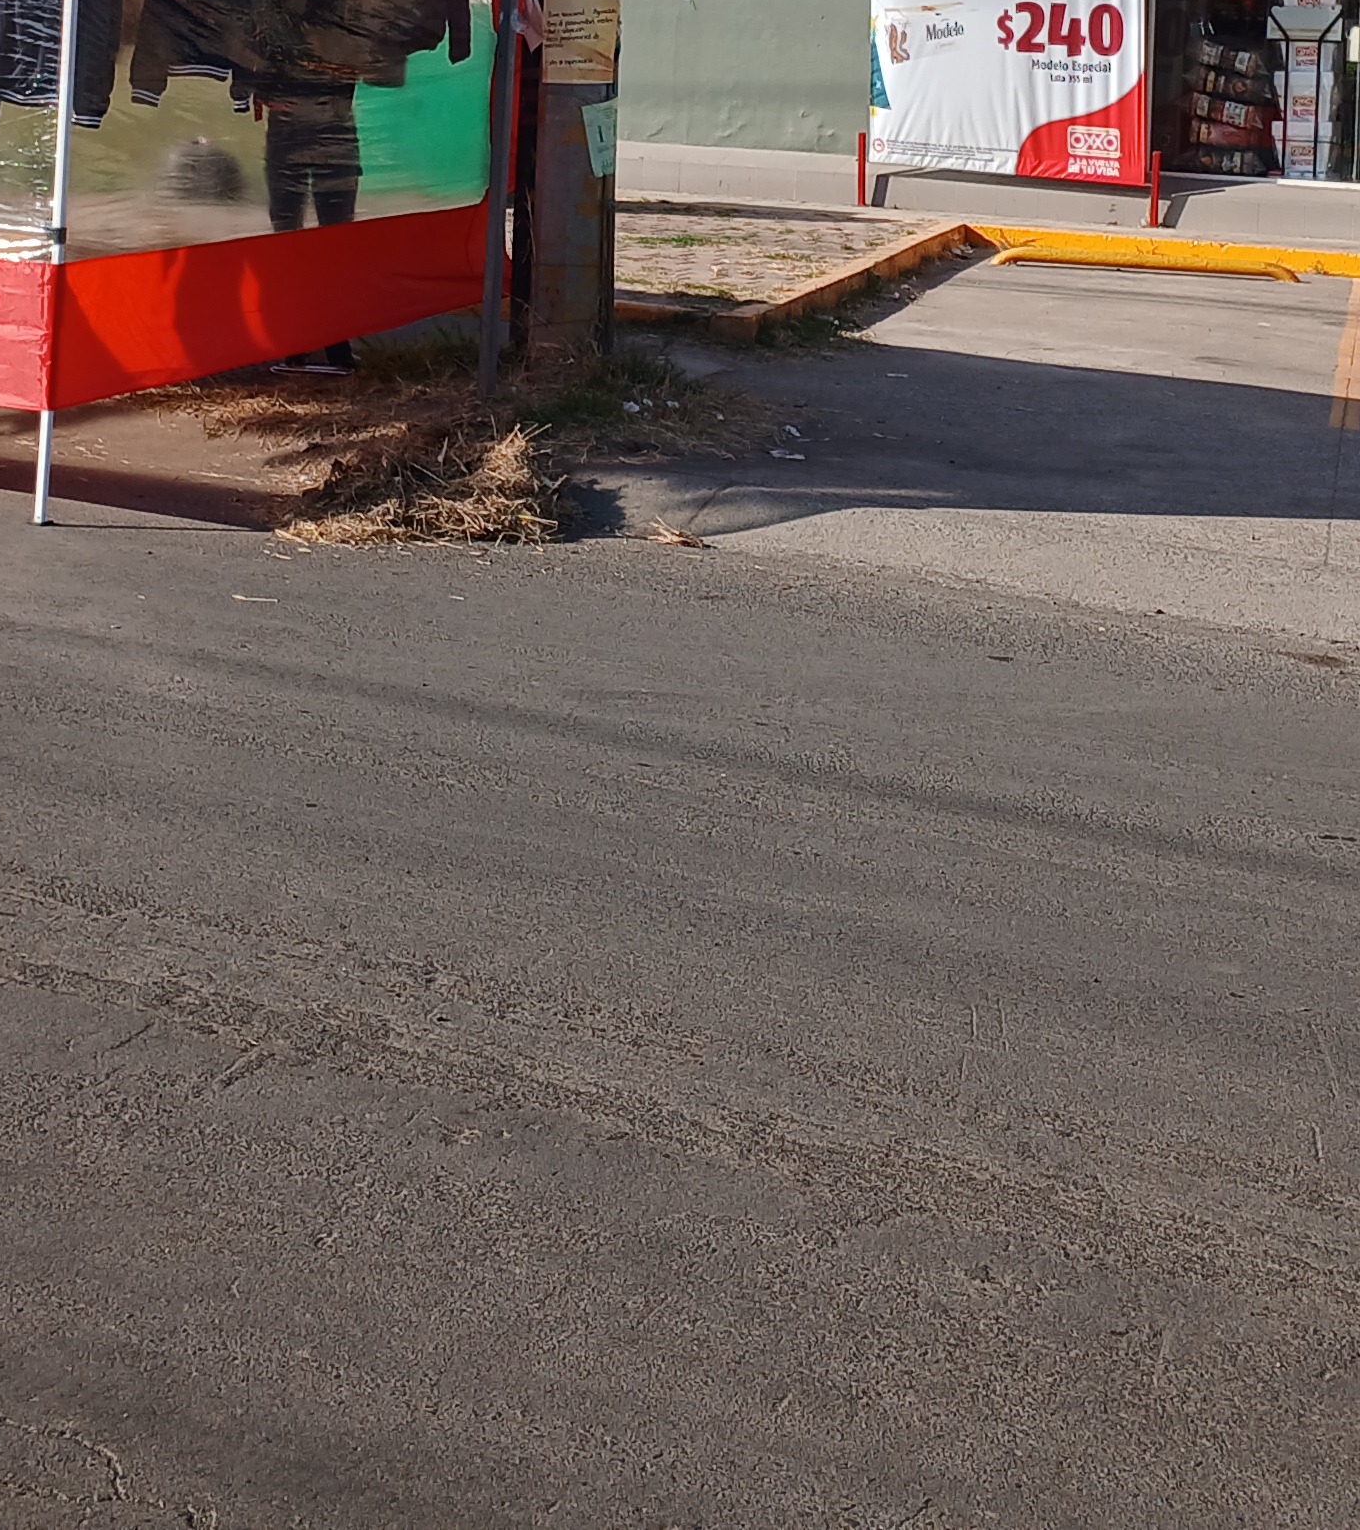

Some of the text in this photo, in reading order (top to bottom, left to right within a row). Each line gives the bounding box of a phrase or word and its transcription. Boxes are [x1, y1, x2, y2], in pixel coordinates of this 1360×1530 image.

[926, 21, 964, 42] Modelo
[996, 1, 1124, 58] $240
[1031, 59, 1112, 74] Modelo Especial
[1069, 130, 1119, 153] OXXO
[1096, 167, 1120, 178] VIDA
